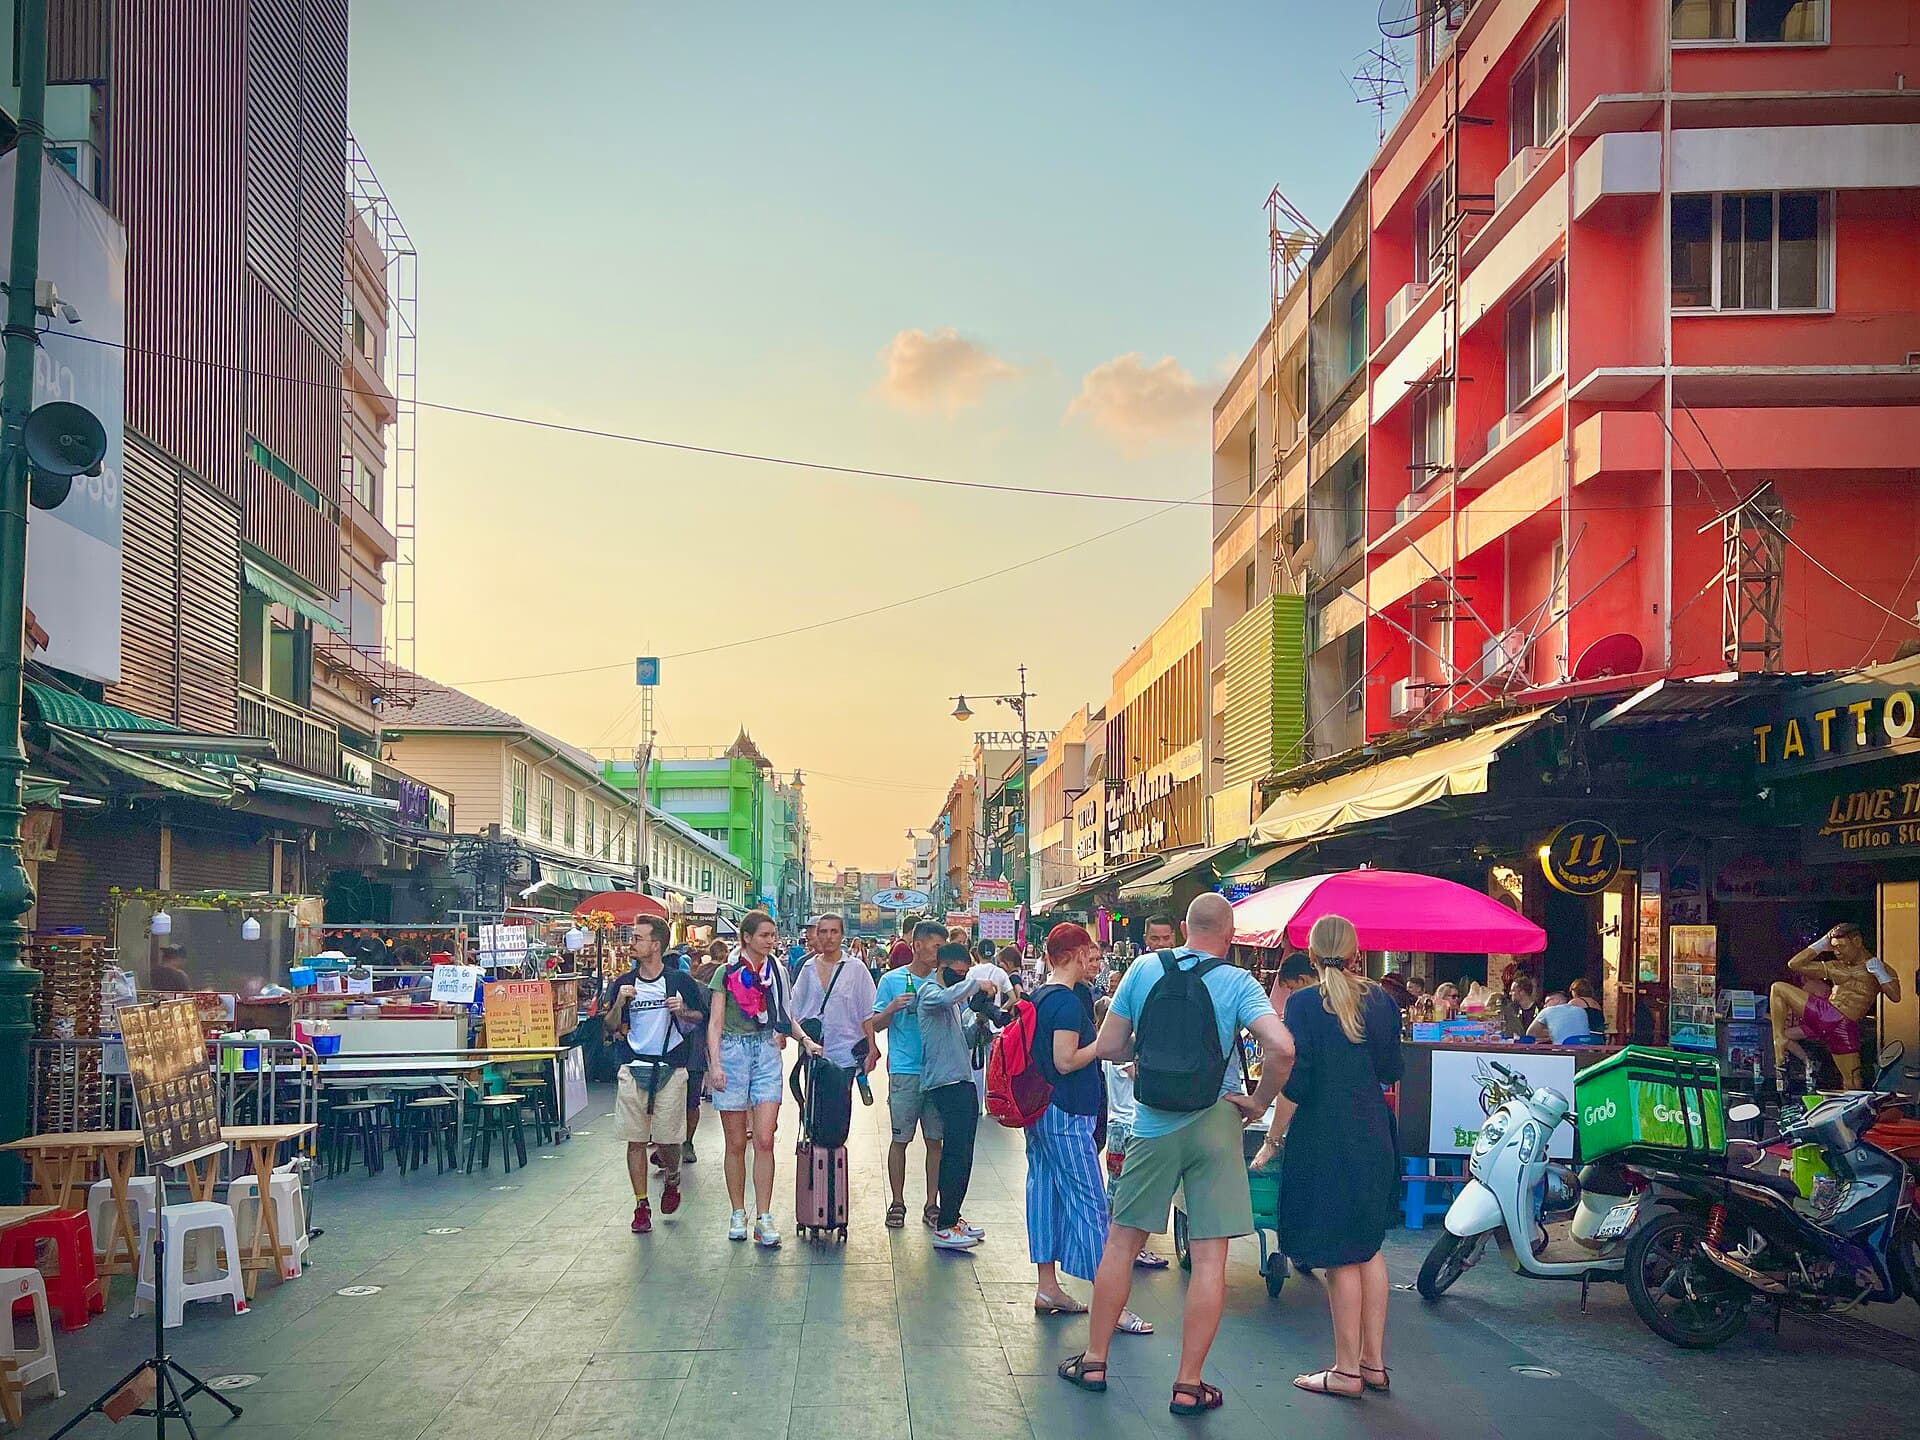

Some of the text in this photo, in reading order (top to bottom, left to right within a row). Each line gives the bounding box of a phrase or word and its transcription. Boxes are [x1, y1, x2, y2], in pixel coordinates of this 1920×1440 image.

[1829, 789, 1895, 824] LINE
[1565, 834, 1606, 866] 11
[1842, 832, 1890, 849] Tattoo
[1584, 1098, 1616, 1126] Grab
